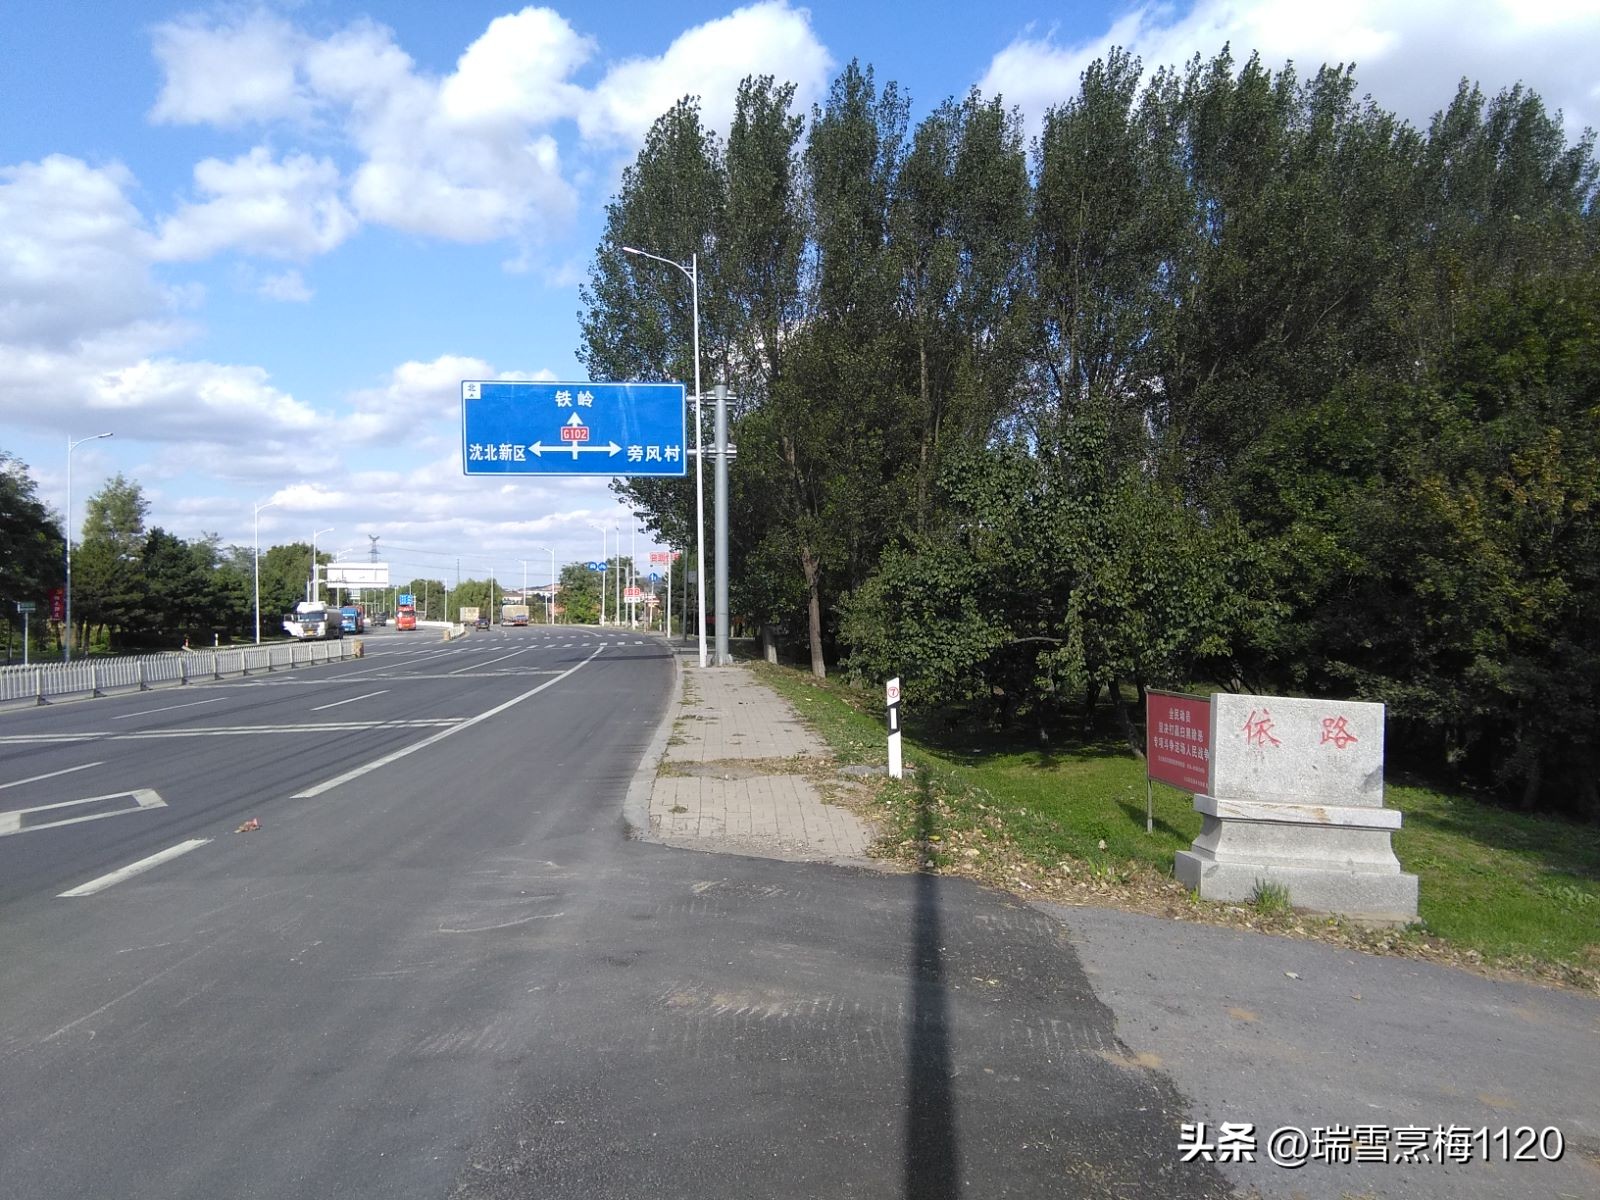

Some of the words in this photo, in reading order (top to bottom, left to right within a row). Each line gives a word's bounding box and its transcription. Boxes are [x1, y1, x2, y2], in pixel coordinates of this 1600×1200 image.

[467, 383, 477, 392] 北
[554, 390, 595, 408] 铁岭
[563, 428, 588, 439] G102
[469, 443, 527, 462] 沈北新区
[627, 444, 681, 462] 旁风村
[1168, 707, 1191, 723] 全民动员
